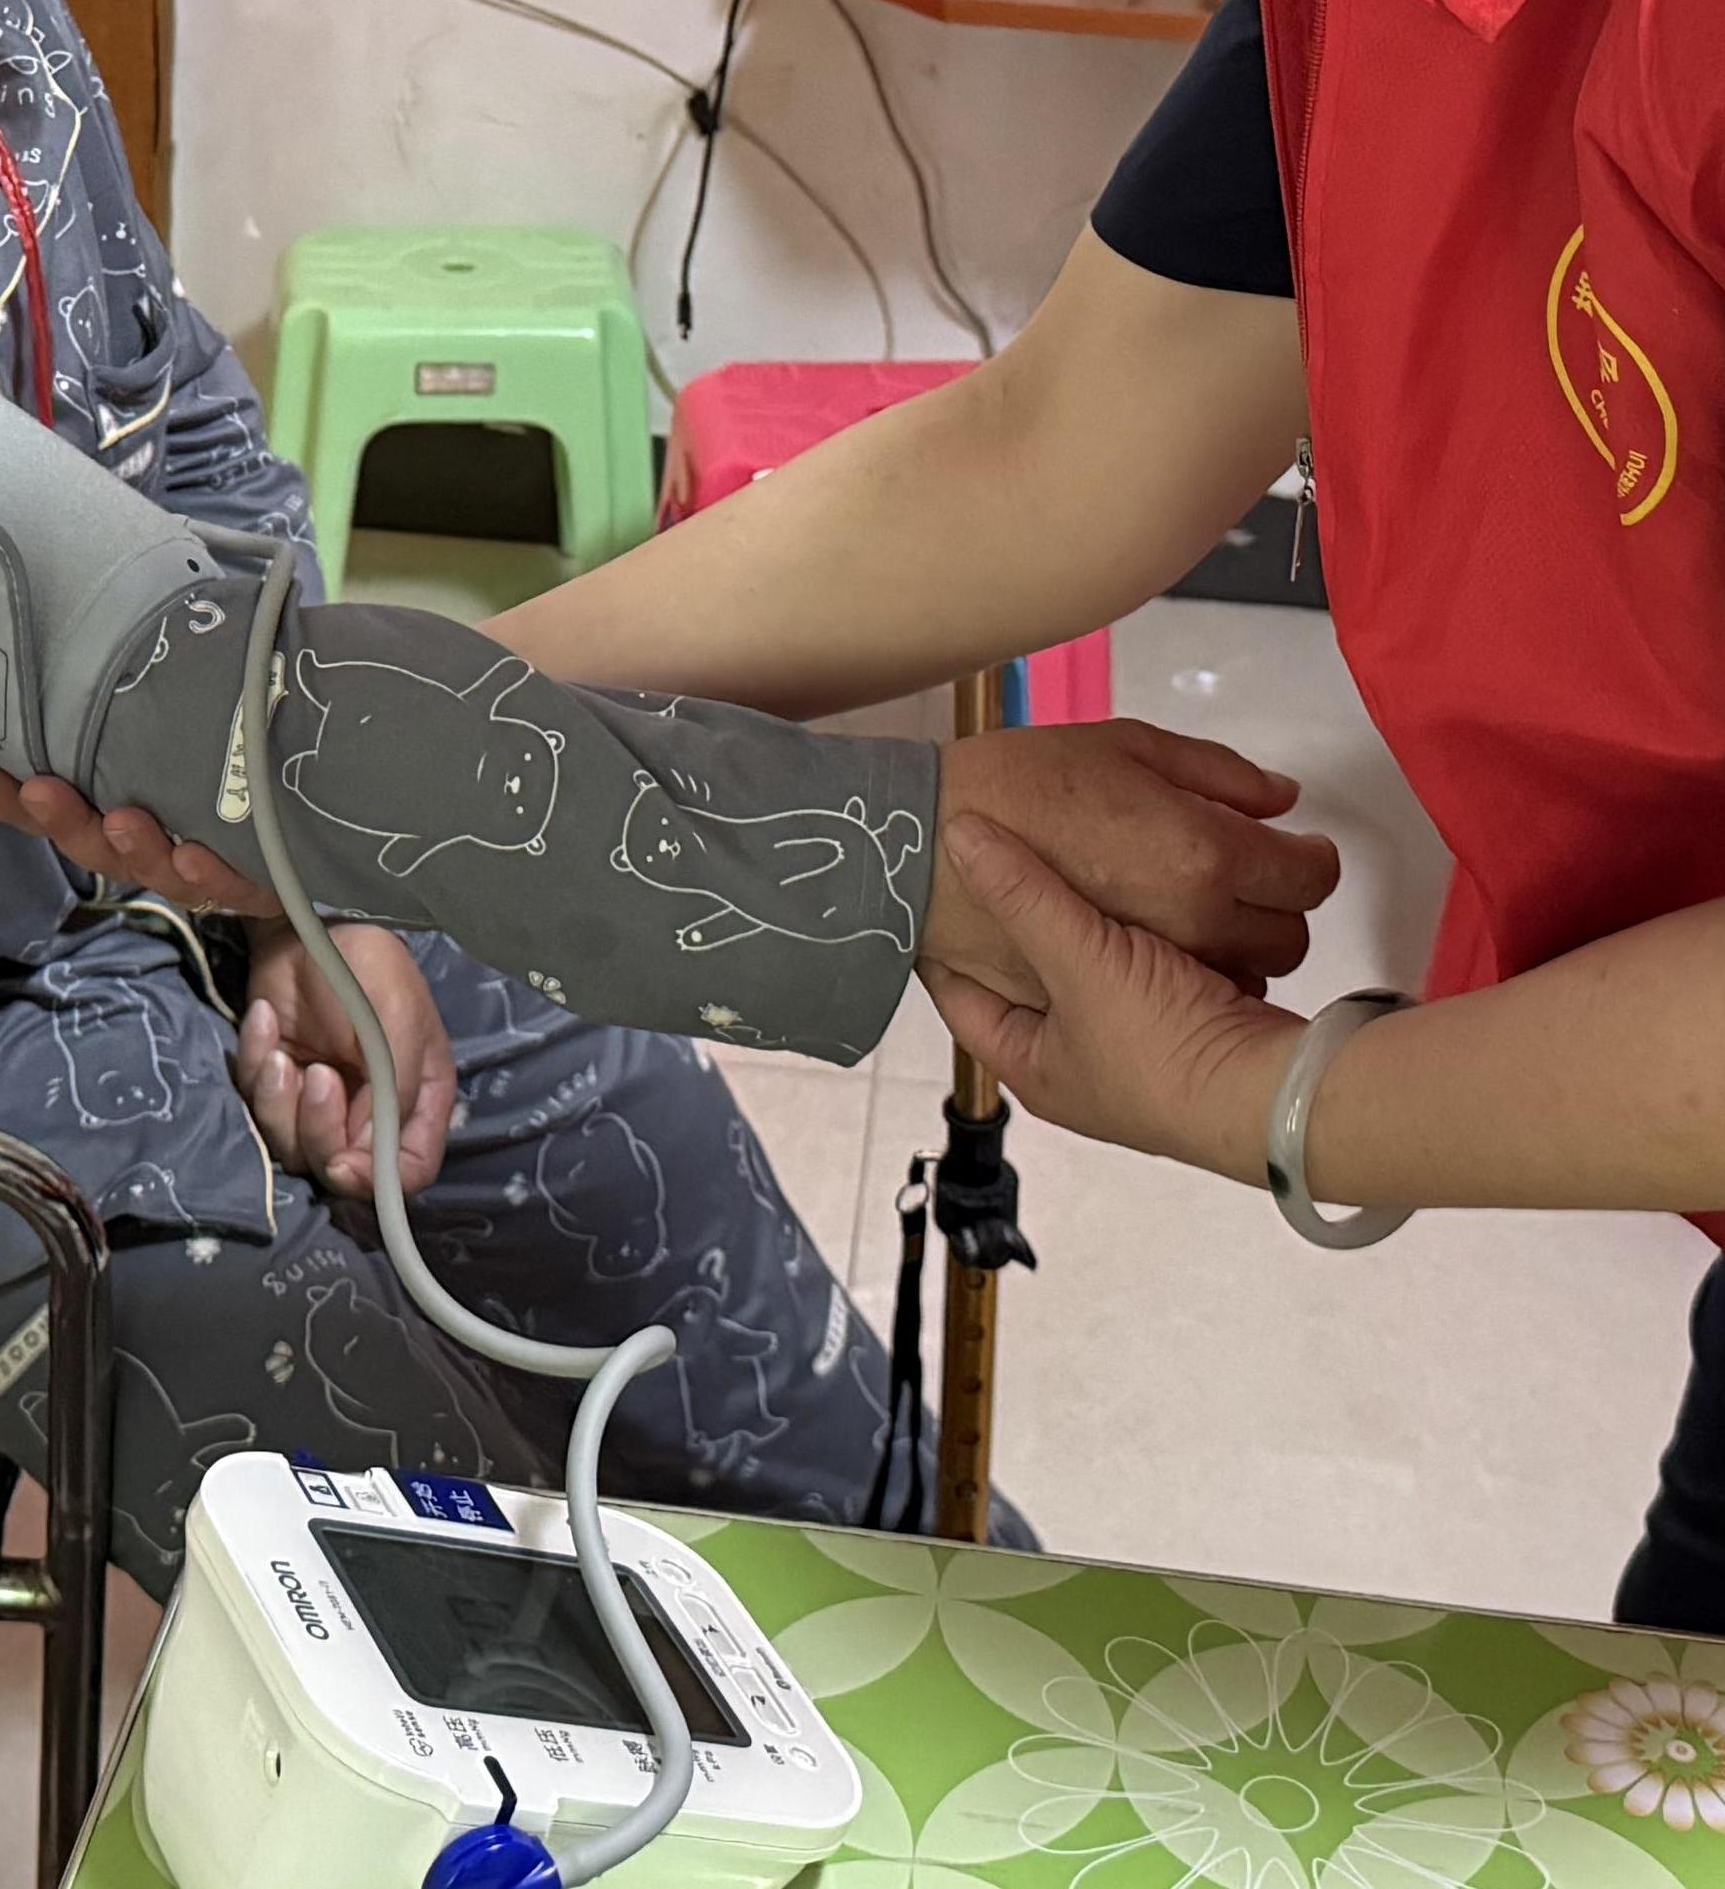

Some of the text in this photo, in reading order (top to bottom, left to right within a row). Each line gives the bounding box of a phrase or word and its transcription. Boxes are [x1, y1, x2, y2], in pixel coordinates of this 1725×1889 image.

[270, 1560, 330, 1641] OMRON
[442, 1714, 479, 1751] 高压
[534, 1727, 569, 1762] 低压
